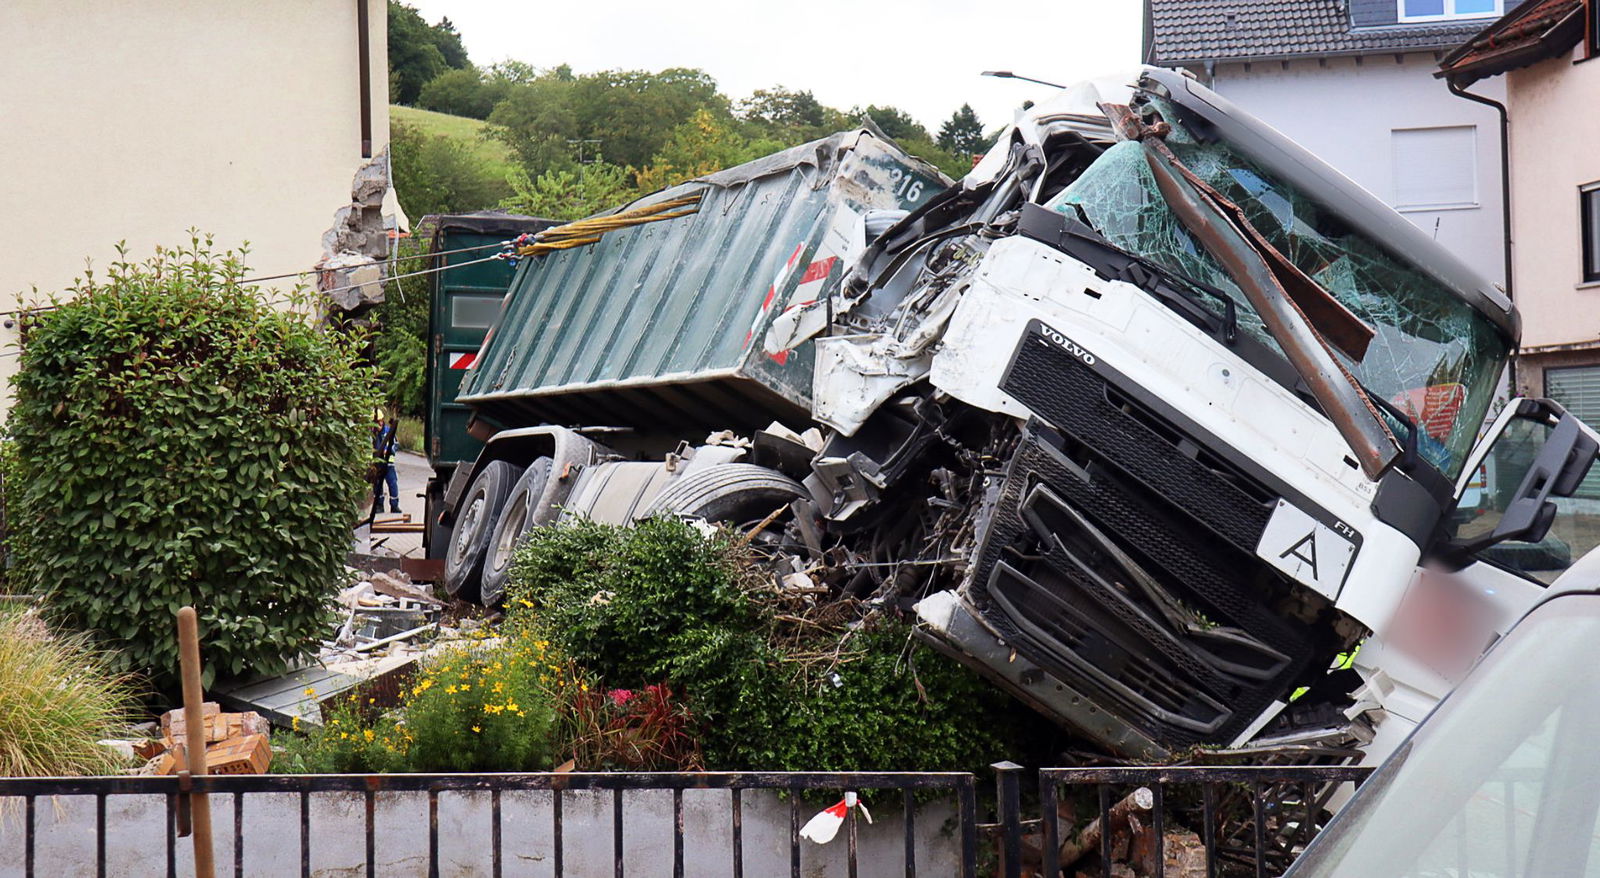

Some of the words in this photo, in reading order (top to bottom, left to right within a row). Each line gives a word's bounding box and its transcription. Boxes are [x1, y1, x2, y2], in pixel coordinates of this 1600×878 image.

[1039, 323, 1096, 366] VOLVO
[1334, 521, 1356, 538] FH
[1279, 528, 1319, 581] A
